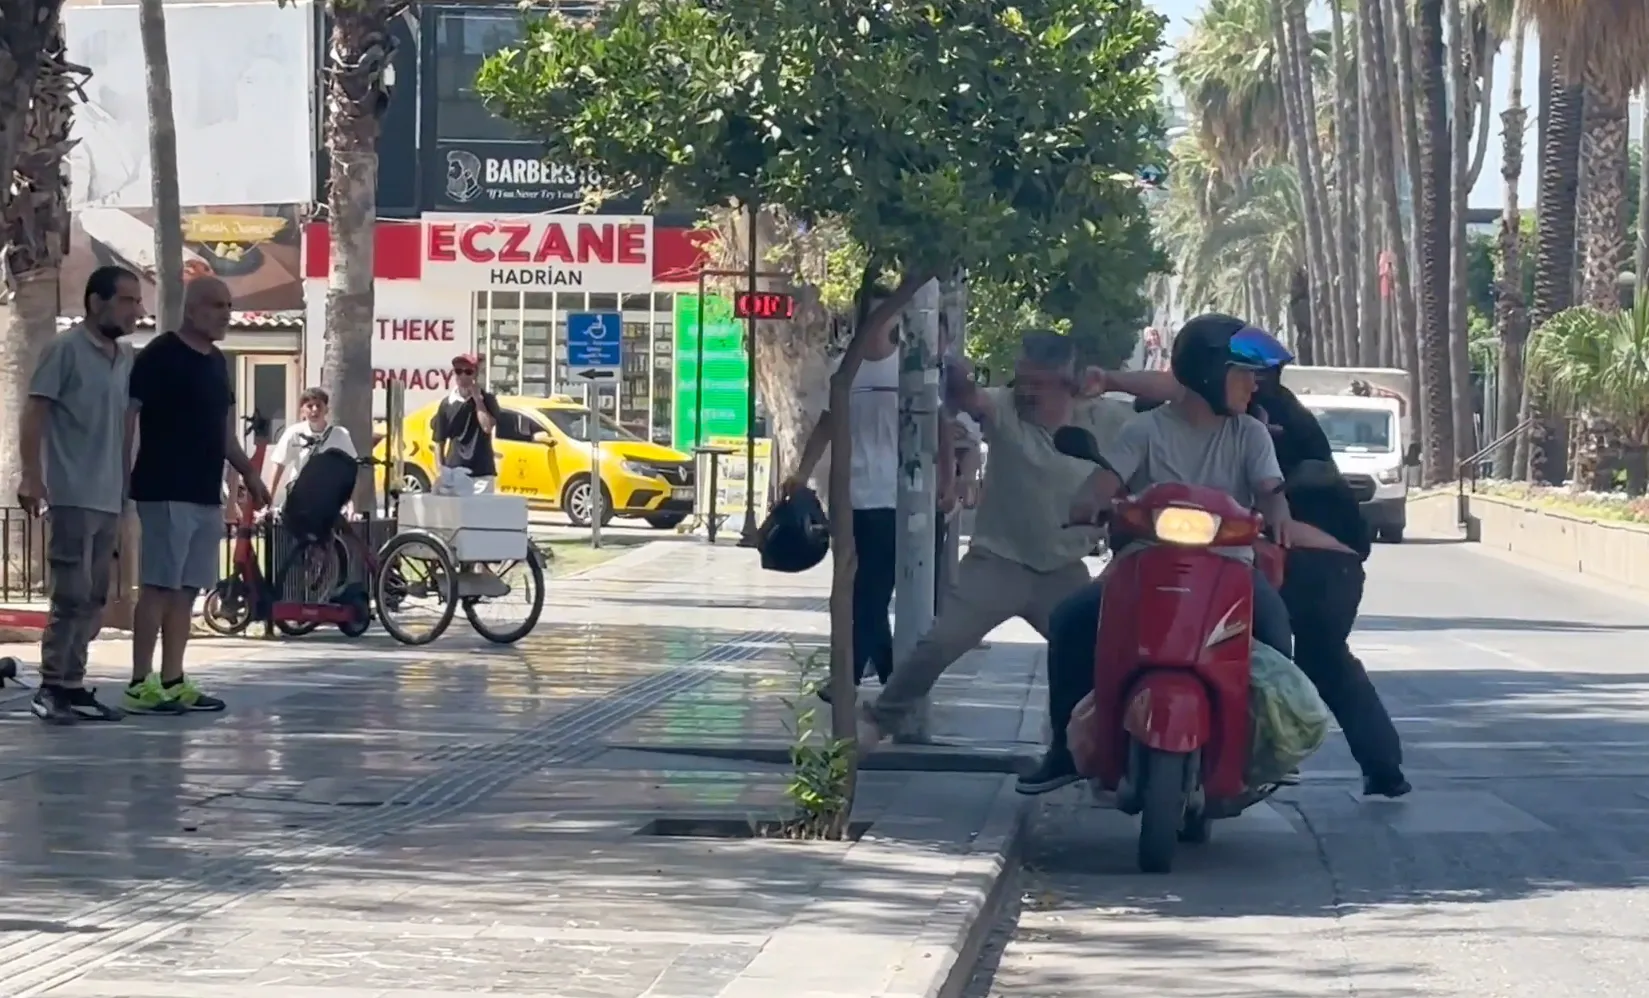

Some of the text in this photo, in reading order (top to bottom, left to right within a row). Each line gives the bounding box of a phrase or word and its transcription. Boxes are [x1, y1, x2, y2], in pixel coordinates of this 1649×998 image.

[427, 220, 647, 264] ECZANE
[490, 265, 583, 286] HADRİAN
[375, 318, 456, 341] THEKE
[372, 367, 454, 390] RMACY
